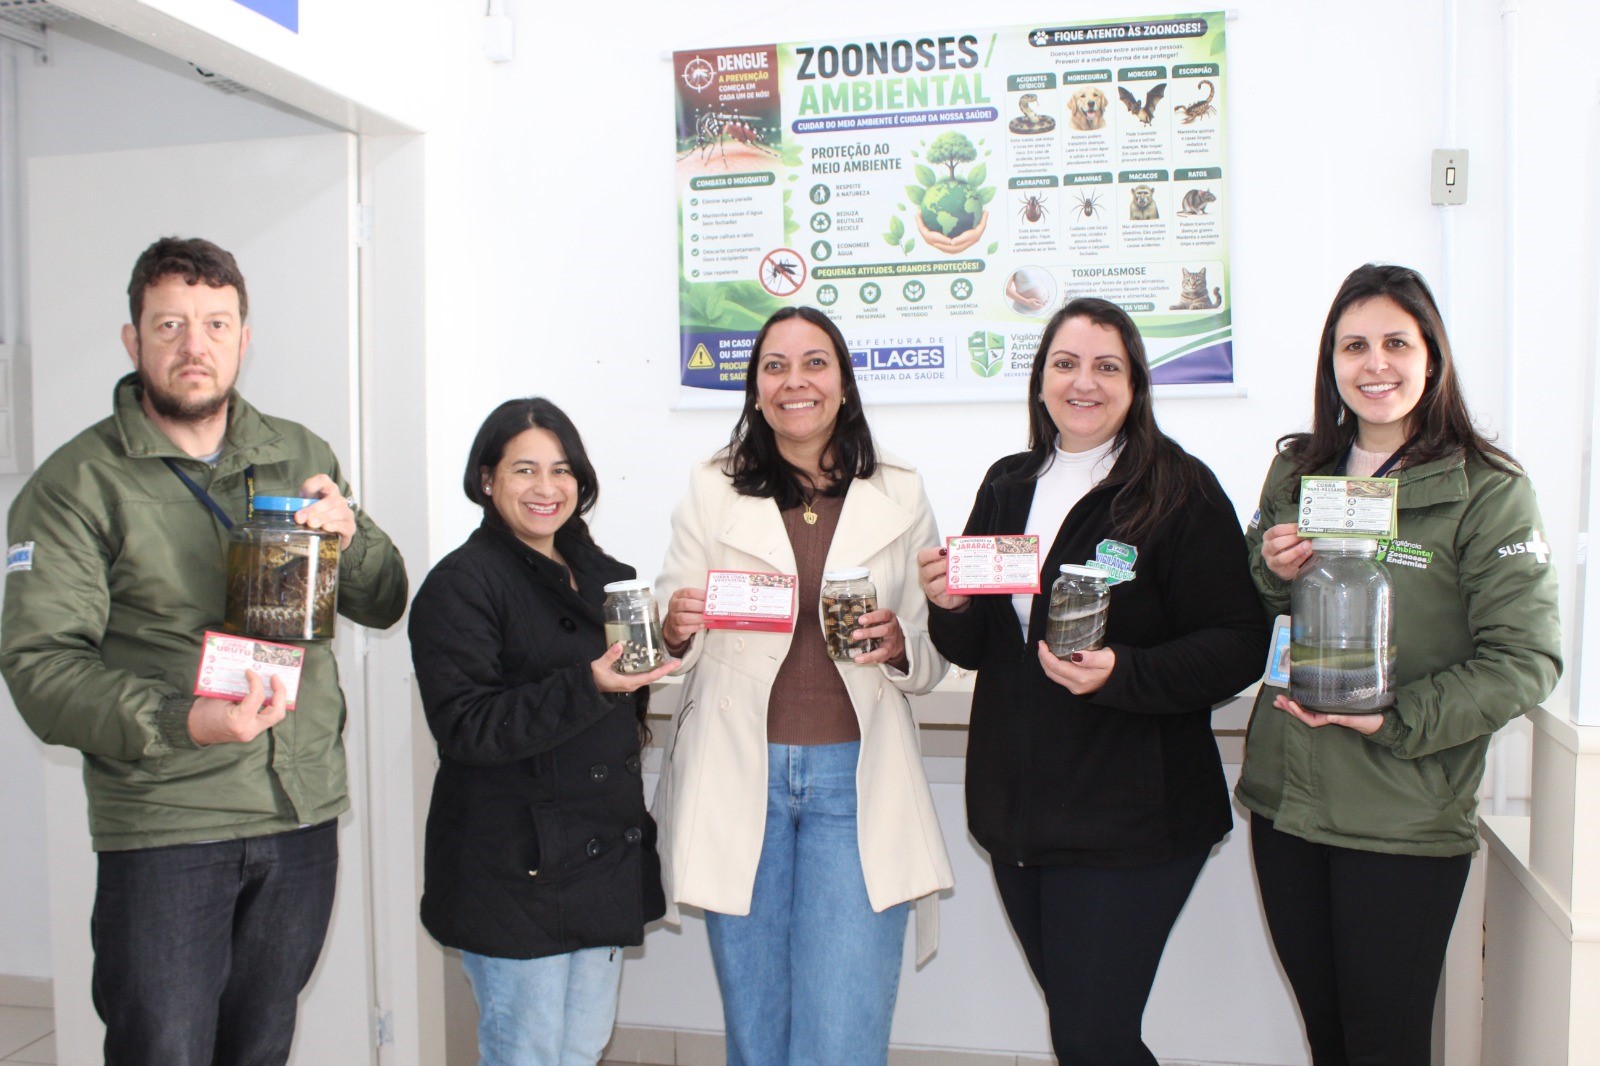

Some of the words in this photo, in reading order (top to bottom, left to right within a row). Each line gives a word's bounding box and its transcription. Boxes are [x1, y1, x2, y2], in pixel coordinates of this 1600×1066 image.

[1054, 30, 1084, 42] FIQUE
[1086, 28, 1125, 40] ATENTO
[1126, 24, 1141, 36] ÀS
[1144, 23, 1201, 36] ZOONOSES!
[1159, 44, 1184, 52] pessoas.
[716, 52, 768, 72] DENGUE
[795, 34, 979, 80] ZOONOSES
[1150, 53, 1178, 61] proteger!
[1128, 70, 1158, 78] MORCEGO
[1178, 66, 1212, 75] ESCORPIÃO
[726, 71, 768, 82] PREVENÇÃO
[1068, 74, 1108, 82] MORDEDURAS
[719, 84, 744, 92] COMEÇA
[719, 93, 736, 101] CADA
[756, 90, 770, 98] NÓS!
[798, 73, 991, 116] AMBIENTAL
[798, 121, 824, 131] CUIDAR
[826, 121, 836, 130] DO
[837, 120, 856, 128] MEIO
[856, 117, 892, 127] AMBIENTE
[894, 114, 900, 124] É
[900, 115, 926, 125] CUIDAR
[928, 114, 938, 122] DA
[939, 112, 964, 122] NOSSA
[965, 109, 992, 121] SAÚDE!
[811, 142, 870, 159] PROTEÇÃO
[874, 143, 890, 155] AO
[812, 162, 840, 174] MEIO
[844, 158, 902, 173] AMBIENTE
[696, 179, 726, 187] COMBATA
[734, 175, 769, 184] MOSQUITO!
[1016, 178, 1050, 186] CARRAPATO
[1074, 175, 1102, 183] ARANHAS
[817, 268, 856, 277] PEQUENAS
[858, 266, 896, 276] ATITUDES,
[896, 265, 932, 274] GRANDES
[932, 261, 979, 272] PROTEÇÕES!
[1072, 267, 1146, 278] TOXOPLASMOSE
[719, 340, 730, 348] EM
[732, 338, 752, 348] CASO
[848, 338, 922, 347] REFEITURA
[1010, 333, 1044, 342] Vigilânc
[720, 350, 730, 359] OU
[732, 350, 752, 358] SINTO
[874, 348, 942, 368] LAGES
[1011, 352, 1036, 360] Zoon
[720, 361, 750, 370] PROCUR
[720, 373, 729, 381] DE
[730, 370, 748, 380] SAÚD
[855, 374, 896, 383] CRETARIA
[899, 372, 912, 380] DA
[914, 370, 944, 380] SAÚDE
[956, 542, 996, 550] JARARACA
[1498, 542, 1525, 558] SUS
[1388, 551, 1426, 563] Zoonoses
[1096, 554, 1132, 572] VIGILÂNCIA
[1386, 557, 1427, 569] Endemias
[216, 646, 251, 656] URUTU
